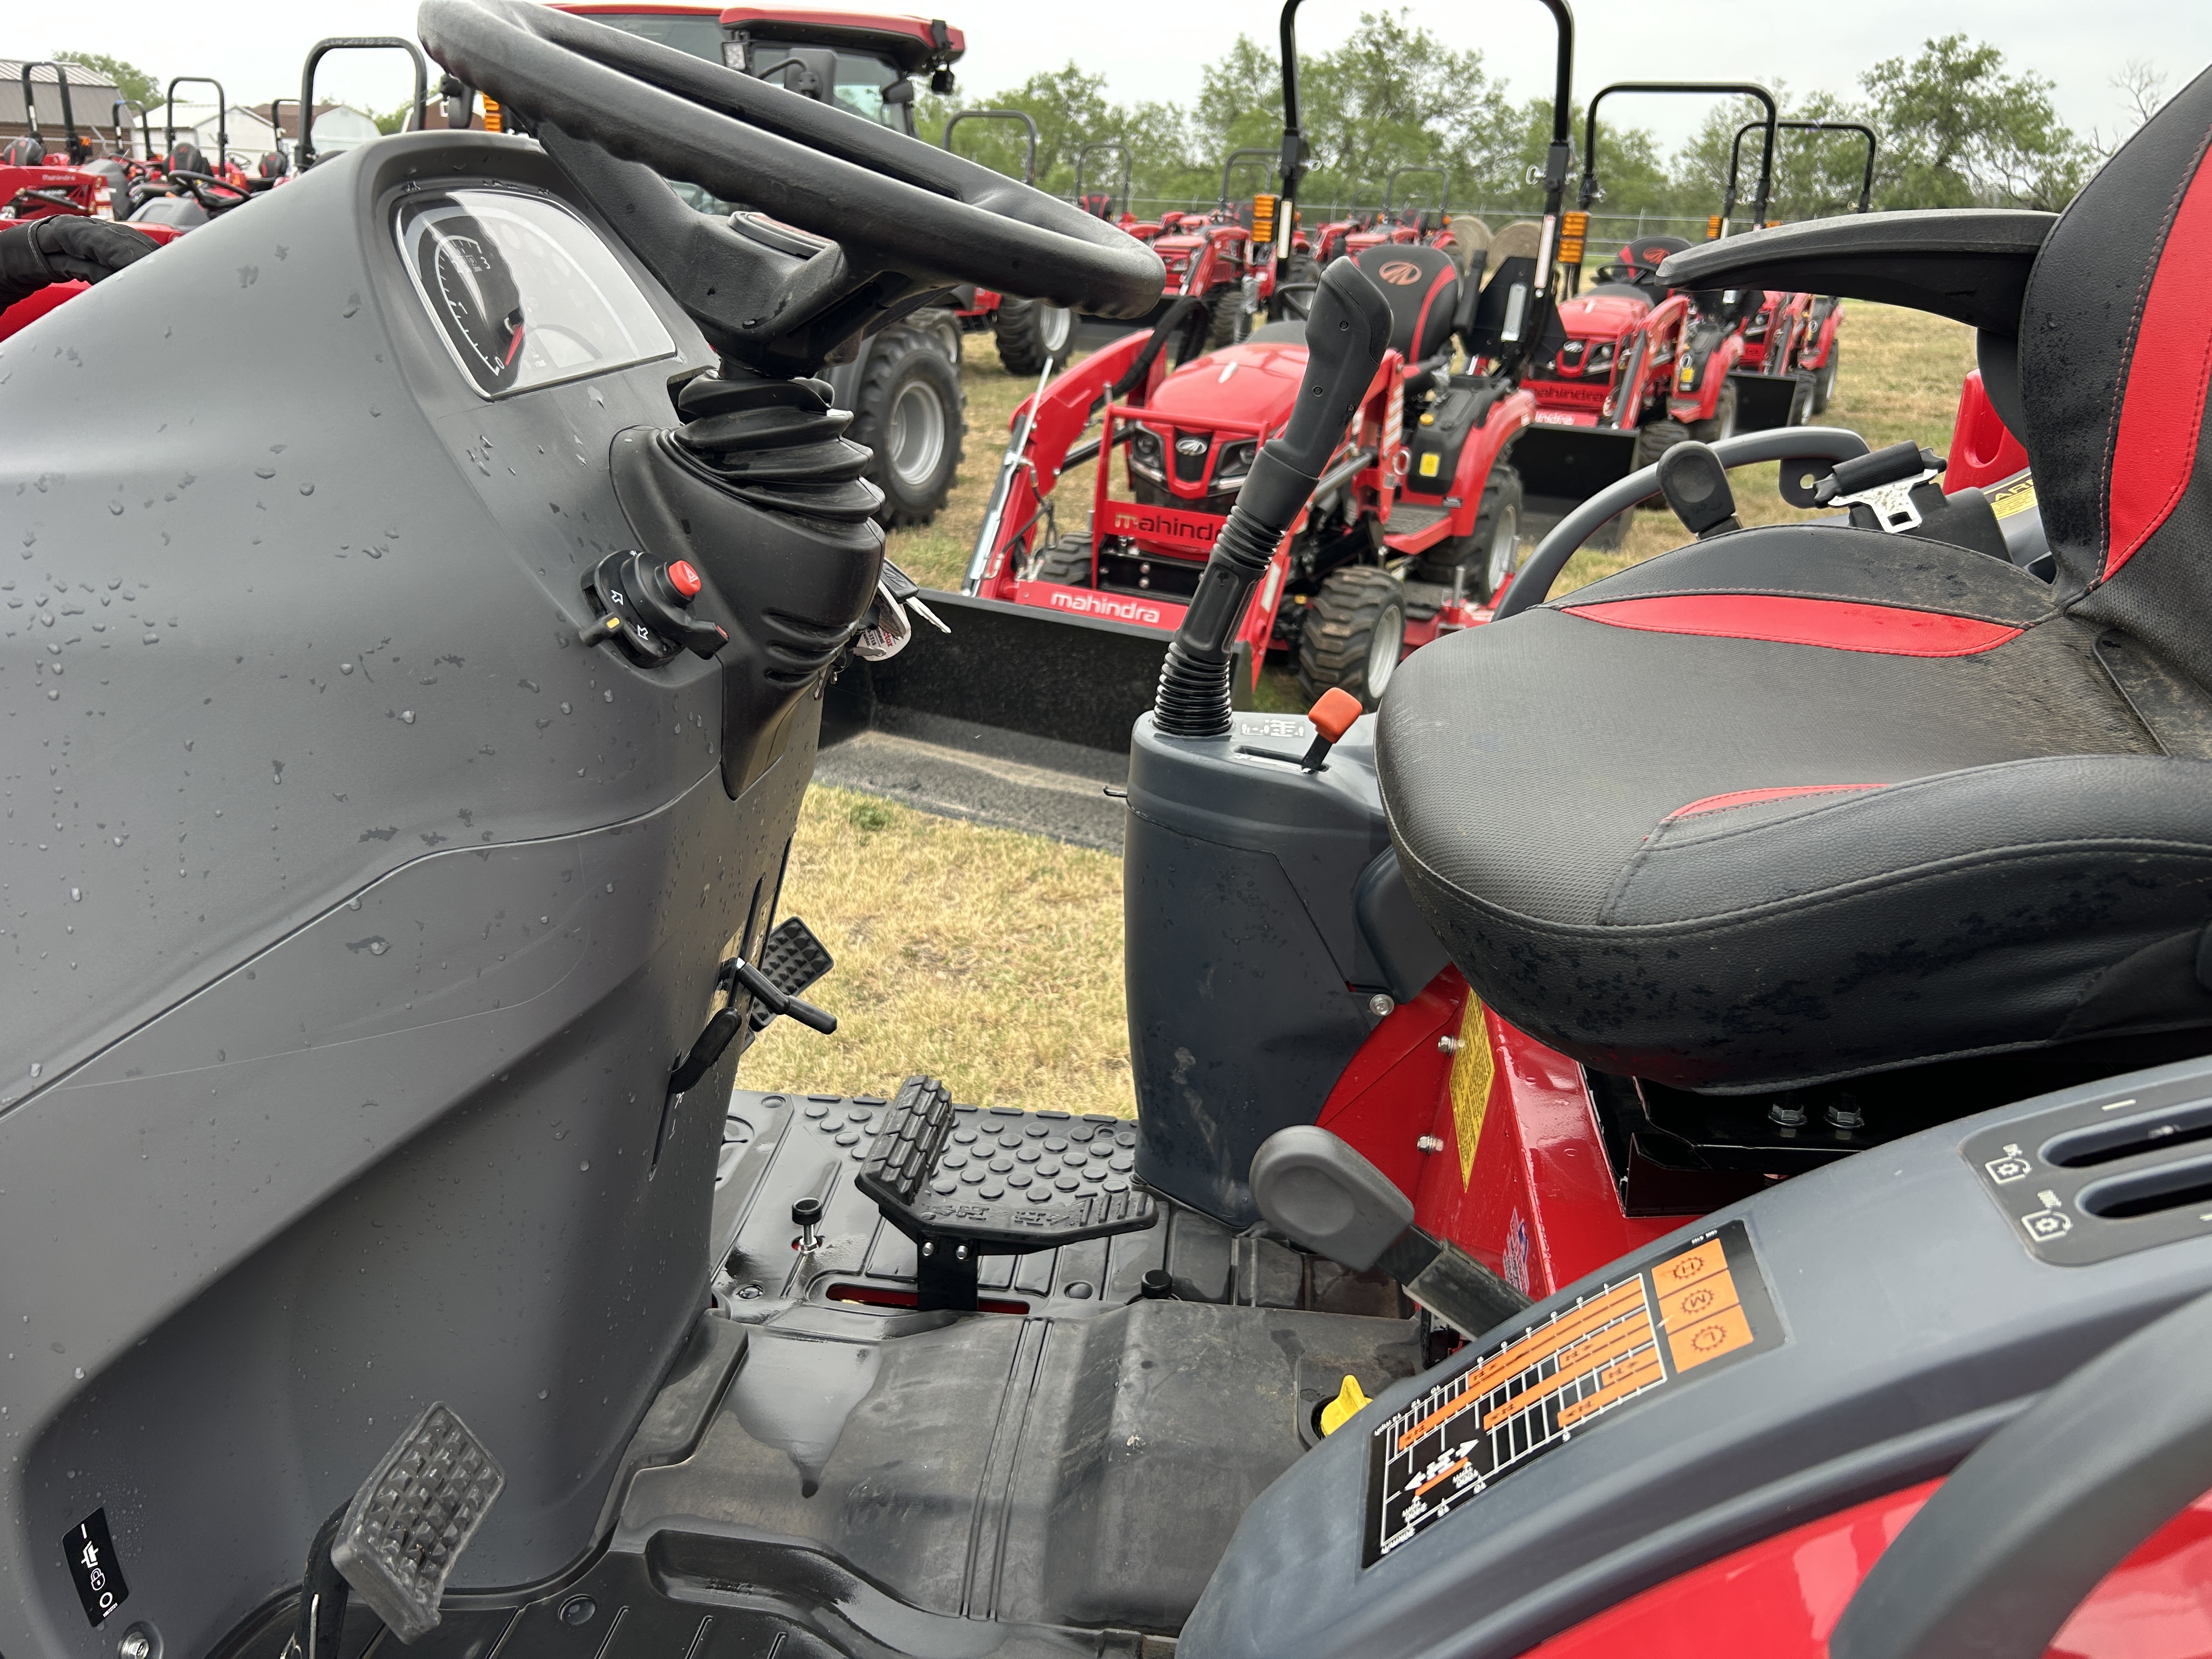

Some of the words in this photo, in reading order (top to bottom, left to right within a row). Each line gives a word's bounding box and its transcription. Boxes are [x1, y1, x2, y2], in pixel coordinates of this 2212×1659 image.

[479, 256, 491, 270] 3
[495, 357, 505, 369] 0
[1050, 591, 1160, 624] mahindra
[1681, 1261, 1695, 1274] H
[1690, 1294, 1706, 1308] M
[1703, 1330, 1716, 1342] L
[1473, 1481, 1487, 1494] 10
[1437, 1504, 1451, 1519] 15
